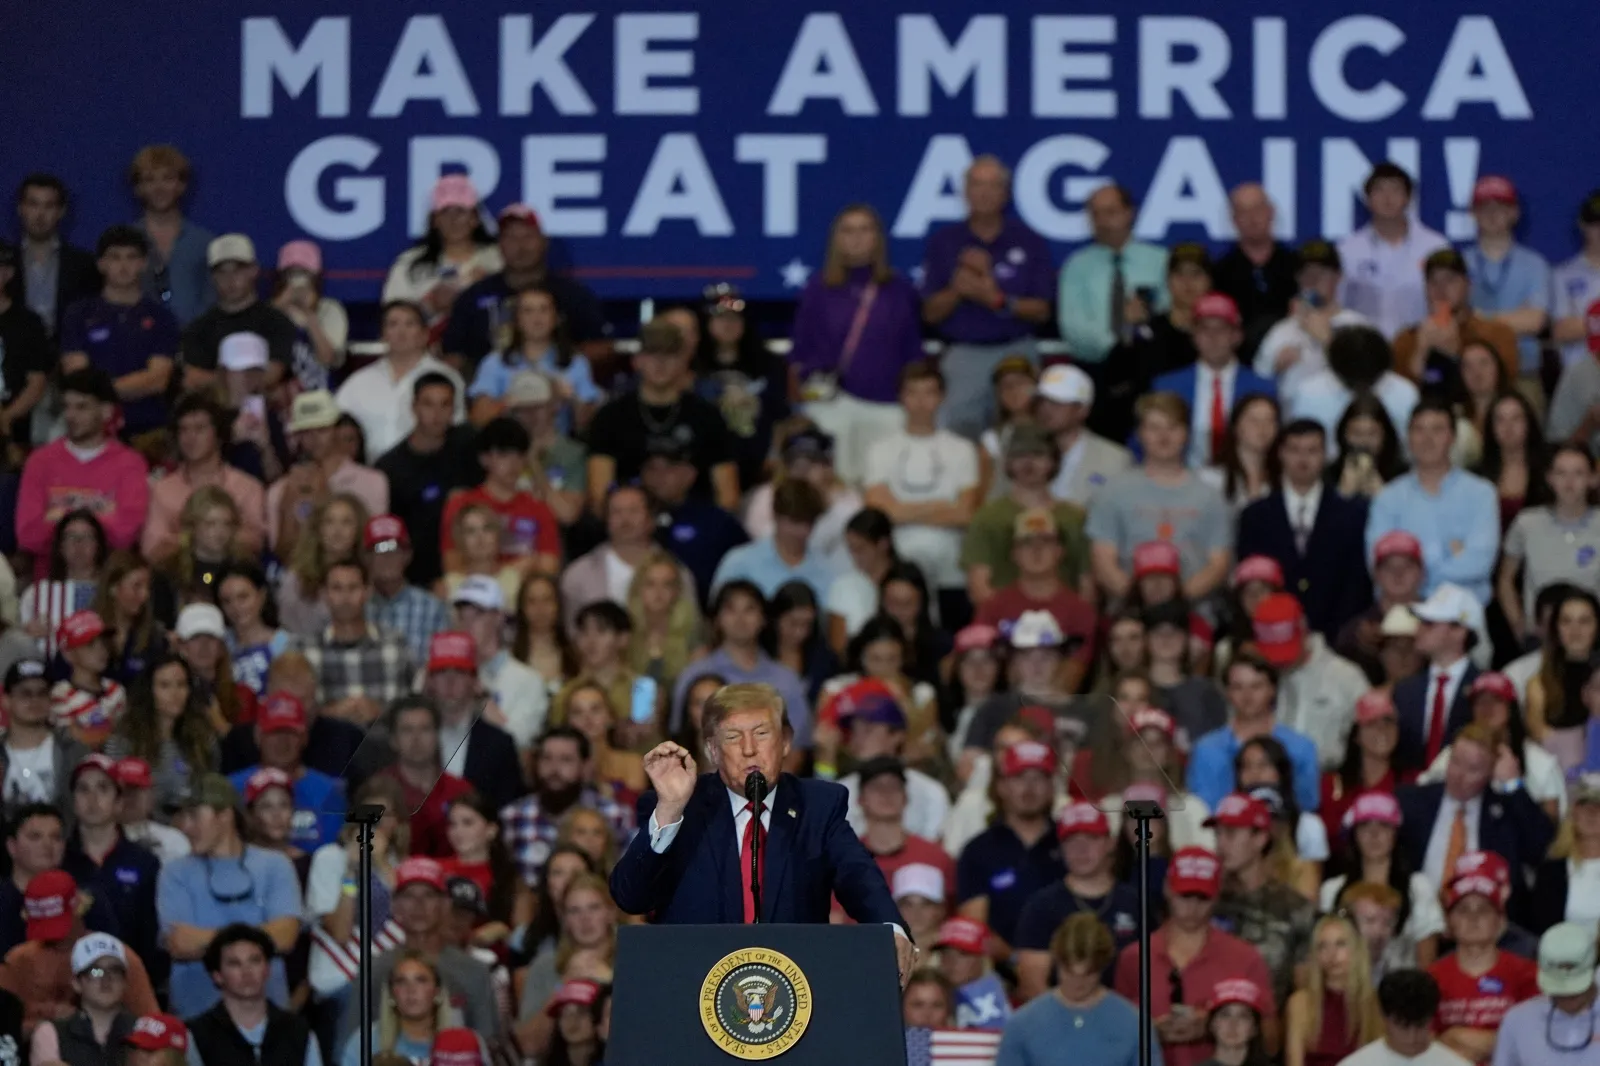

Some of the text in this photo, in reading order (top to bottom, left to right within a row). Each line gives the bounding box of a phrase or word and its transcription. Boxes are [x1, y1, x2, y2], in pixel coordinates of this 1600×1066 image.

[240, 12, 1533, 121] MAKE AMERICA
[285, 133, 827, 240] GREAT
[704, 952, 752, 1001] PRESIDENT
[768, 955, 782, 966] THE
[784, 964, 808, 1010] UNITED
[709, 1022, 719, 1033] OF
[719, 1031, 747, 1054] SEAL
[766, 1019, 803, 1054] STATES
